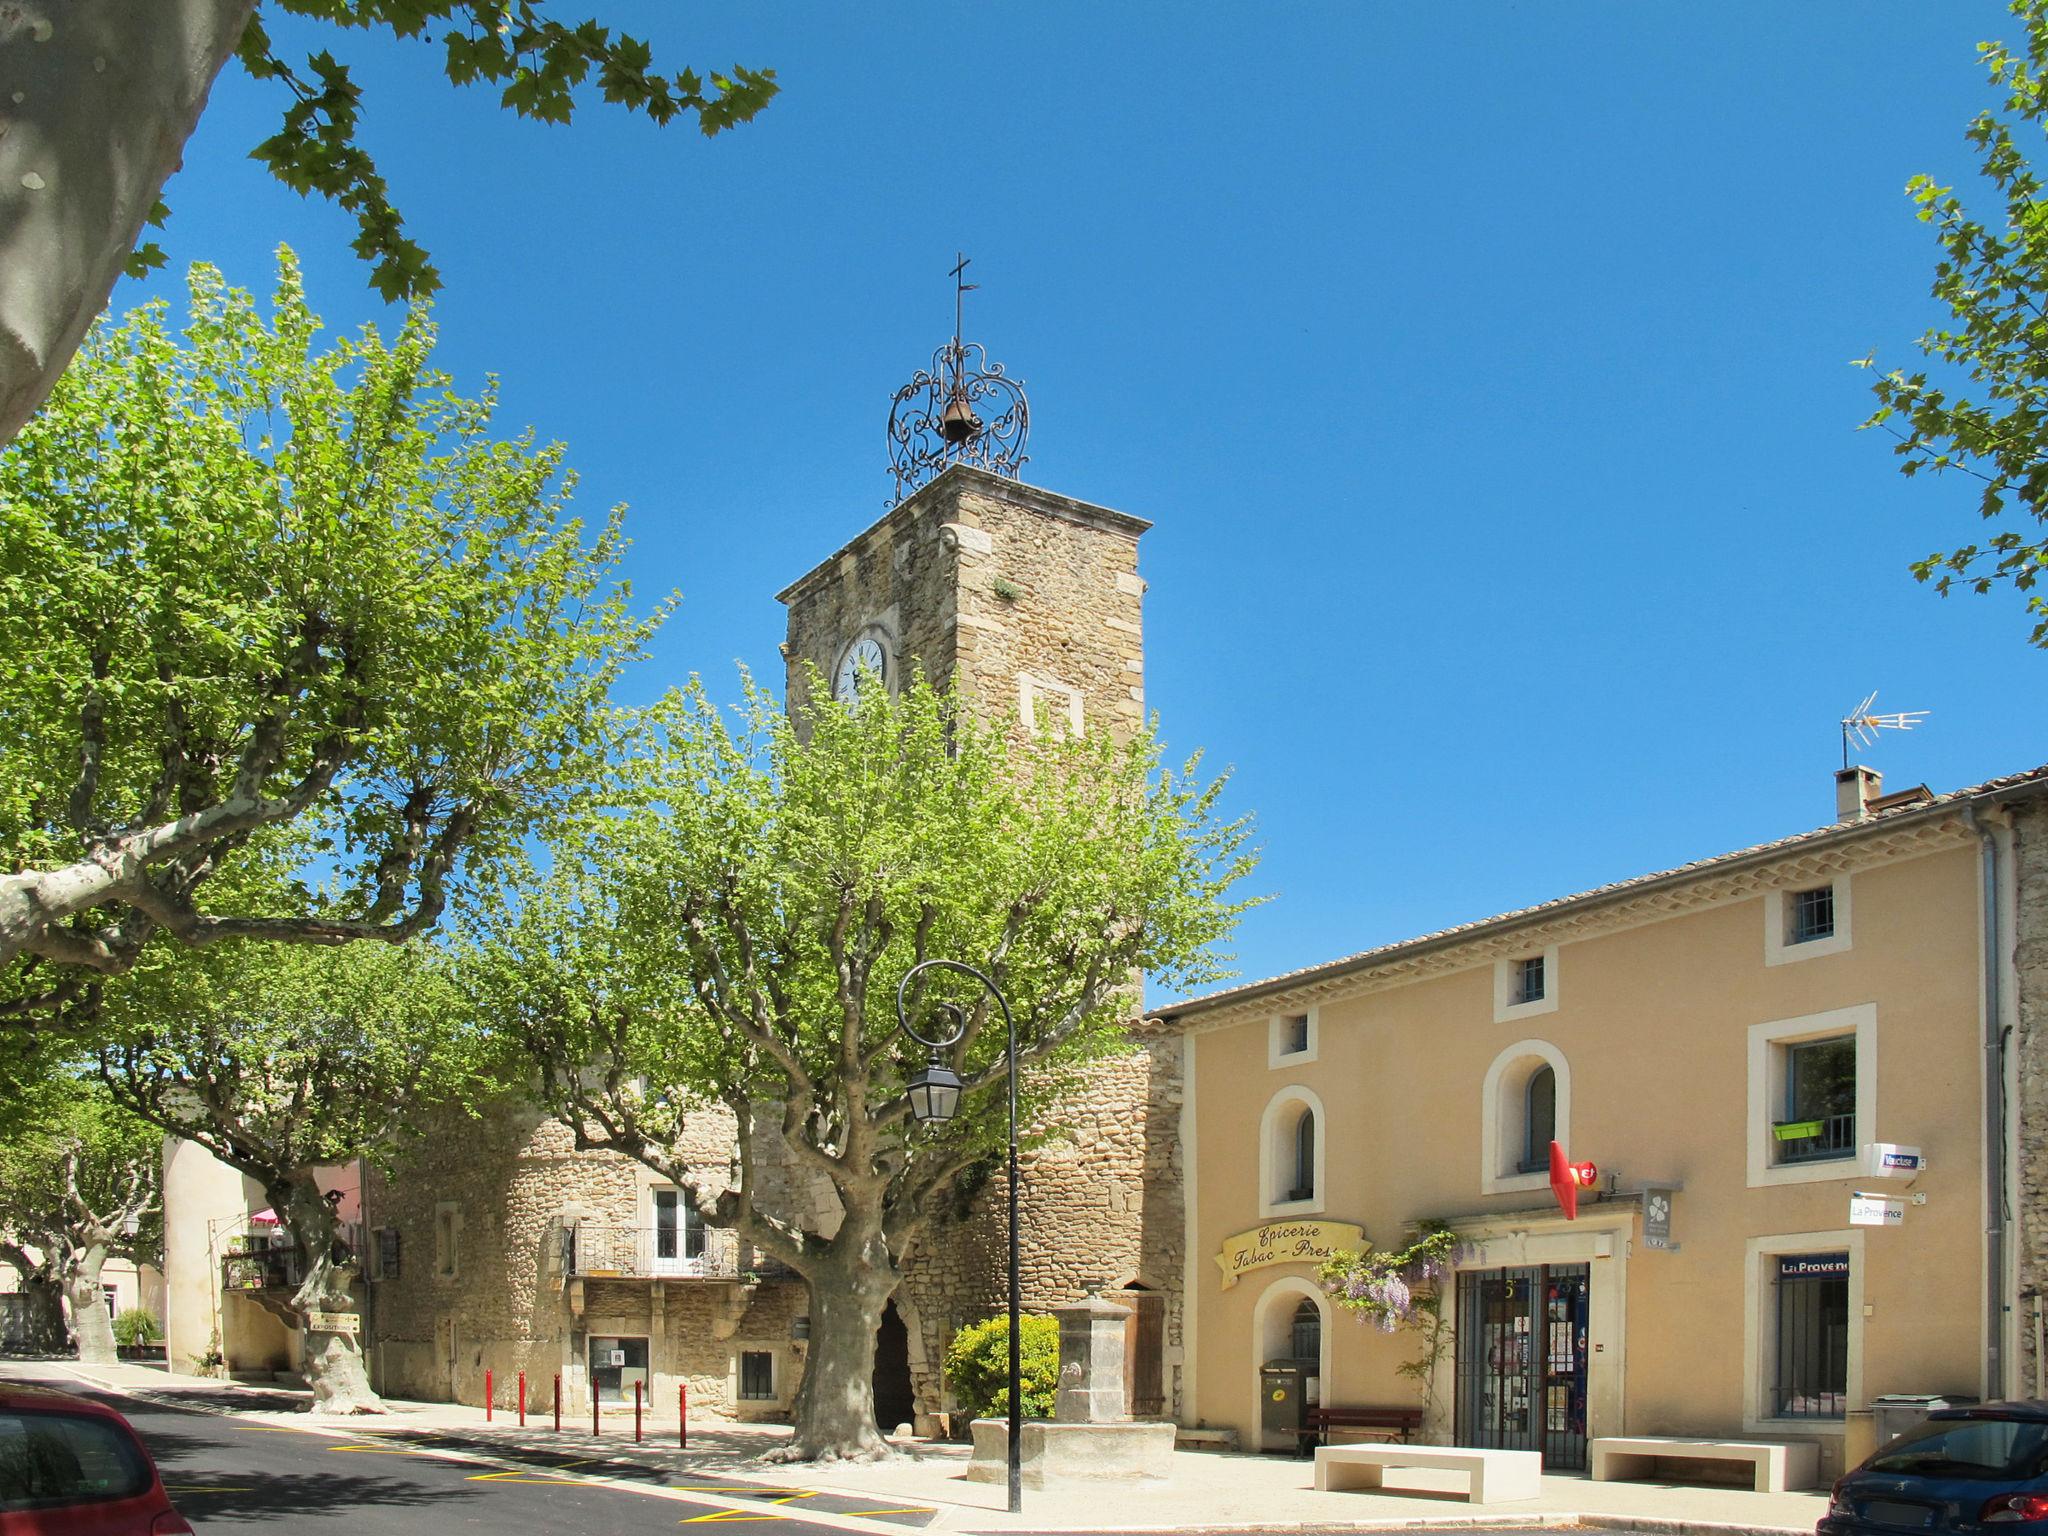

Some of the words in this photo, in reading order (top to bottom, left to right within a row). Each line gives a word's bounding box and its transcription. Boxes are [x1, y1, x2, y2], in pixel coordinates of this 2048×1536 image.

[1885, 1155, 1913, 1166] Vaucluse
[1852, 1205, 1863, 1216] La
[1864, 1206, 1903, 1218] Provence
[1258, 1224, 1320, 1247] Epicerie
[1232, 1247, 1275, 1271] Tabac
